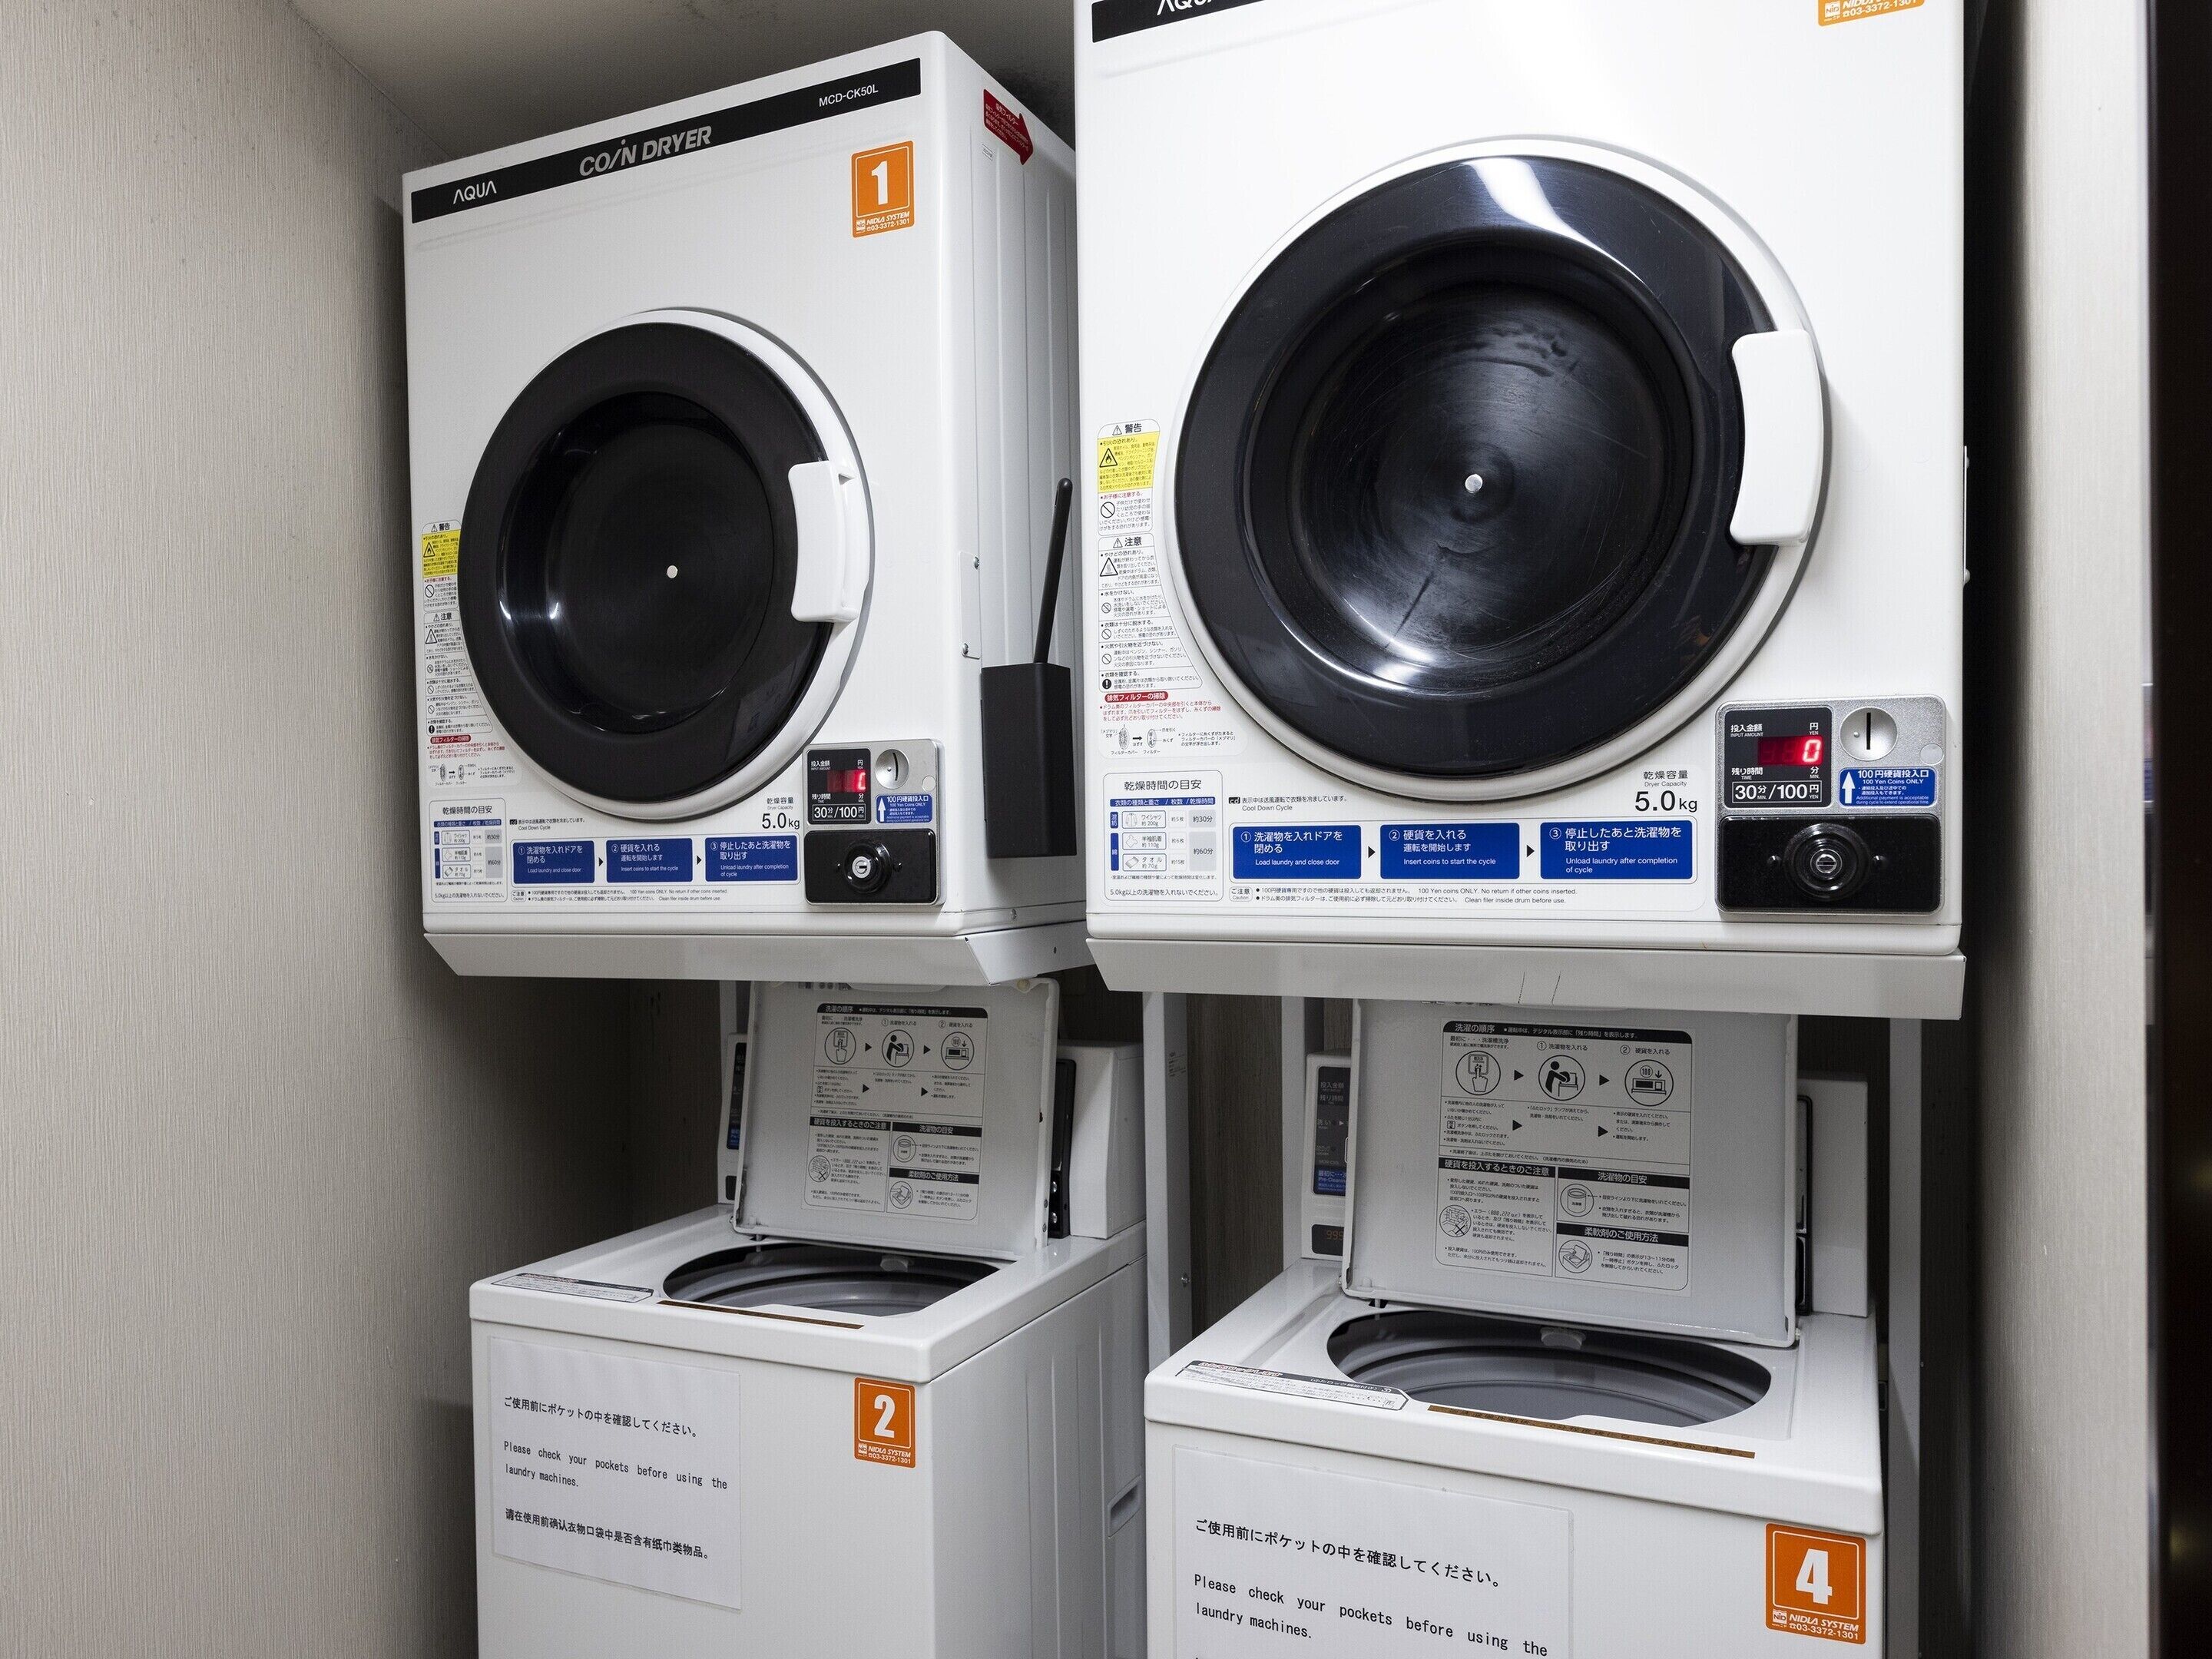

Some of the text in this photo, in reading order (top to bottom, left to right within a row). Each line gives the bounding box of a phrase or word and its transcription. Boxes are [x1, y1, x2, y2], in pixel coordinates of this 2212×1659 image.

[819, 84, 879, 107] MCD-CK50L
[579, 126, 712, 177] COIN DRYER
[871, 161, 889, 205] 1
[453, 180, 497, 204] AQUA
[886, 211, 910, 221] SYSTEM
[871, 219, 910, 231] 03-3372-1301
[1125, 422, 1142, 434] 警告
[1125, 536, 1142, 547] 注意
[1107, 692, 1166, 702] 排気フィルターの掃除
[1730, 724, 1763, 733] 投入金額
[1810, 722, 1819, 730] 円
[1803, 739, 1822, 763] 0
[1644, 770, 1688, 780] 乾燥容量
[1731, 767, 1763, 776] 残り時間
[1811, 766, 1820, 774] 分
[1124, 779, 1202, 792] 乾燥時間の目安
[767, 796, 794, 805] 乾燥容量
[442, 805, 493, 815] 乾燥時間の目安
[1276, 804, 1293, 813] Cycle
[1254, 831, 1343, 843] 洗濯物を入れドアを
[1403, 830, 1467, 841] 硬貨を入れる
[1565, 826, 1681, 839] 停止したあと洗濯物を
[527, 845, 584, 855] 洗濯物を入れドアを
[621, 843, 661, 853] 硬貨を入れる
[720, 840, 791, 850] 停止したあと洗濯物を
[1254, 843, 1283, 854] 閉める
[1403, 843, 1471, 853] 運転を開始します
[1565, 841, 1611, 853] 取り出す
[527, 855, 546, 865] 閉める
[720, 851, 748, 861] 取り出す
[1566, 857, 1678, 866] Unload laundry after completion
[1231, 887, 1250, 896] ご注意
[1455, 1023, 1495, 1033] 洗濯の順序
[1445, 1159, 1549, 1177] 硬貨を投入するときのご注意
[1598, 1171, 1647, 1184] 洗濯物の目安
[1584, 1227, 1659, 1243] 柔軟剤のご使用方法
[504, 1396, 697, 1438] ご使用前にポケットの中を確認してください。
[874, 1394, 896, 1439] 2
[872, 1453, 911, 1464] 03-3372-1301
[887, 1449, 912, 1458] SYSTEM
[504, 1440, 727, 1490] Please check your pockets before using the
[505, 1464, 579, 1488] laundry machines.
[505, 1508, 709, 1559] 请在使用前确认衣物口袋中是否含有纸巾类物品。
[1196, 1518, 1500, 1588] ご使用前にポケットの中を確認してください。
[1796, 1548, 1833, 1605] 4
[1194, 1574, 1548, 1656] Please check your pockets before using the
[1196, 1603, 1312, 1639] laundry machines.
[1820, 1619, 1859, 1632] SYSTEM
[1796, 1624, 1859, 1641] 03-3372-1301
